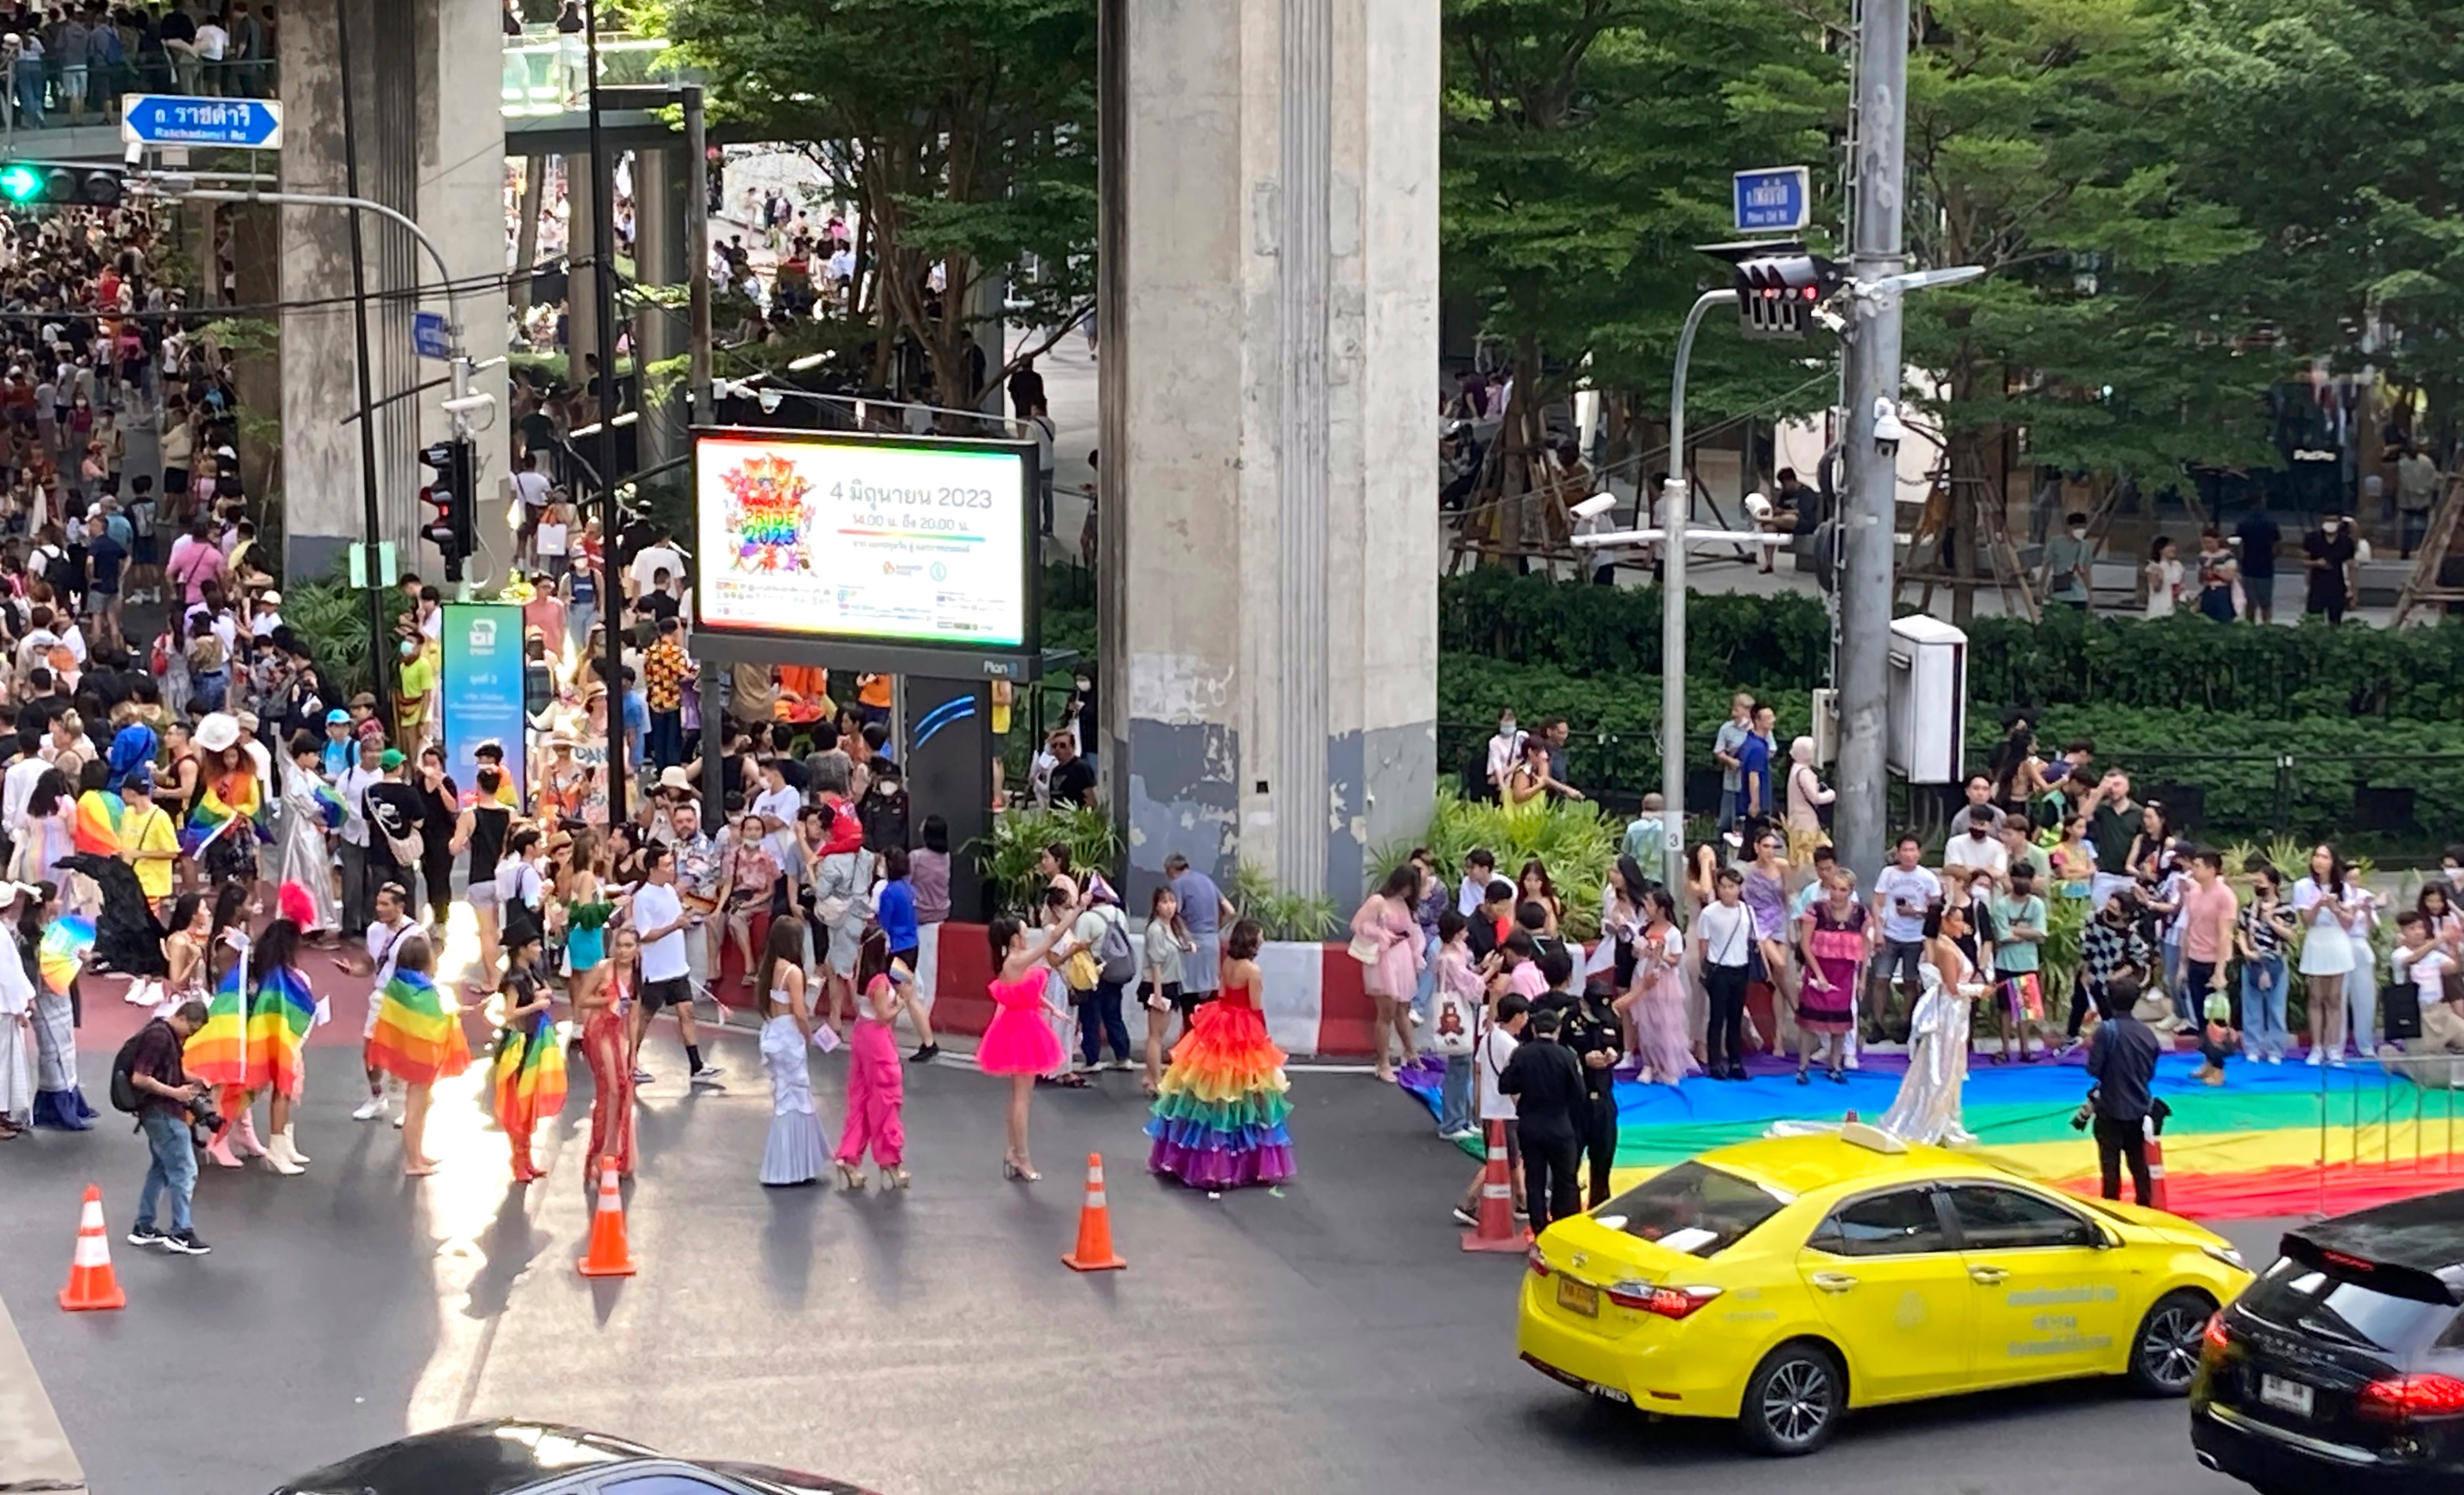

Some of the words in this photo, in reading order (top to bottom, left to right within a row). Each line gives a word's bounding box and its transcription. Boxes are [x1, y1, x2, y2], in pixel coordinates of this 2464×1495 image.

[830, 481, 843, 501] 4
[849, 478, 932, 511] มิถุนายน
[938, 487, 993, 509] 2023
[746, 509, 796, 527] PRIDE
[742, 525, 796, 546] 2023
[1669, 833, 1678, 848] 3
